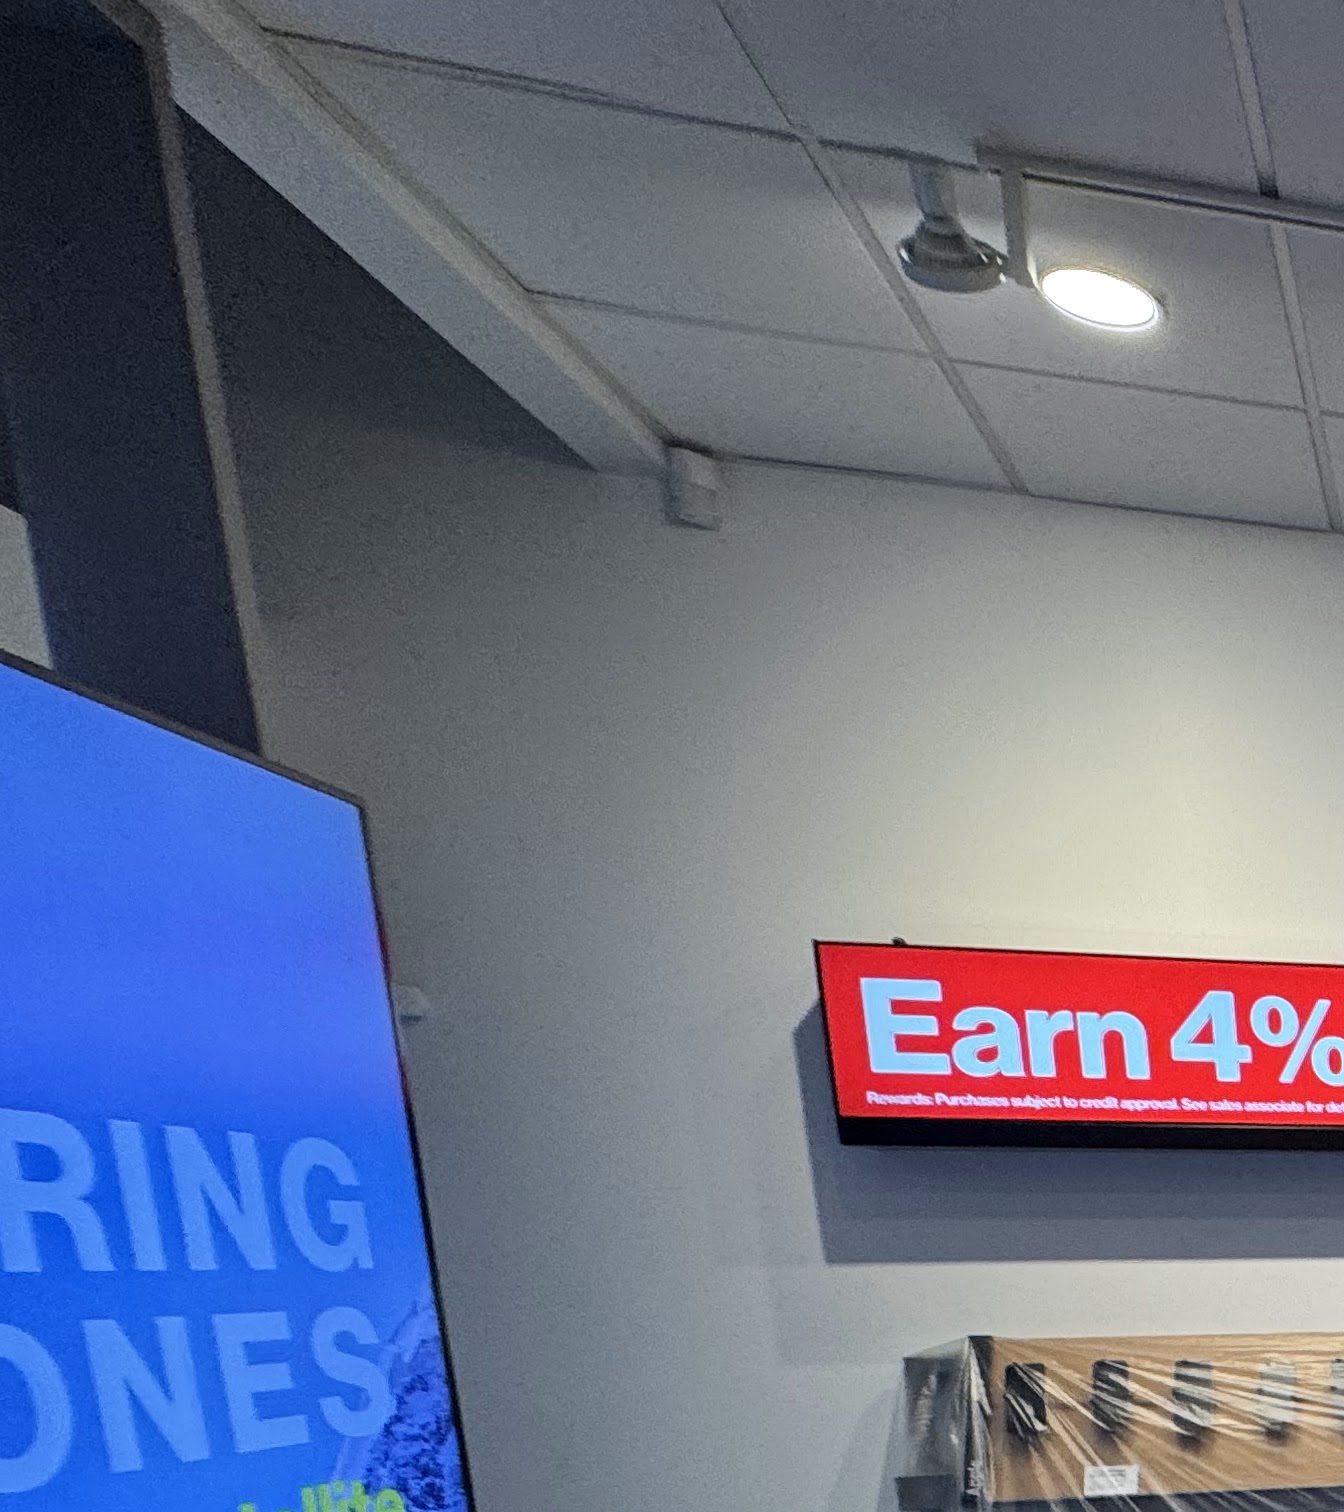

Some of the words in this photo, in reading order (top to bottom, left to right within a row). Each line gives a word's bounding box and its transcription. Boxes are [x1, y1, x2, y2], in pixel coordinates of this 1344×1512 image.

[860, 977, 1150, 1081] Earn
[1011, 1095, 1062, 1110] subject
[1063, 1095, 1078, 1108] to
[1180, 1097, 1208, 1111] See
[1209, 1098, 1243, 1111] sales
[1306, 1101, 1324, 1113] for
[0, 1106, 375, 1273] RING
